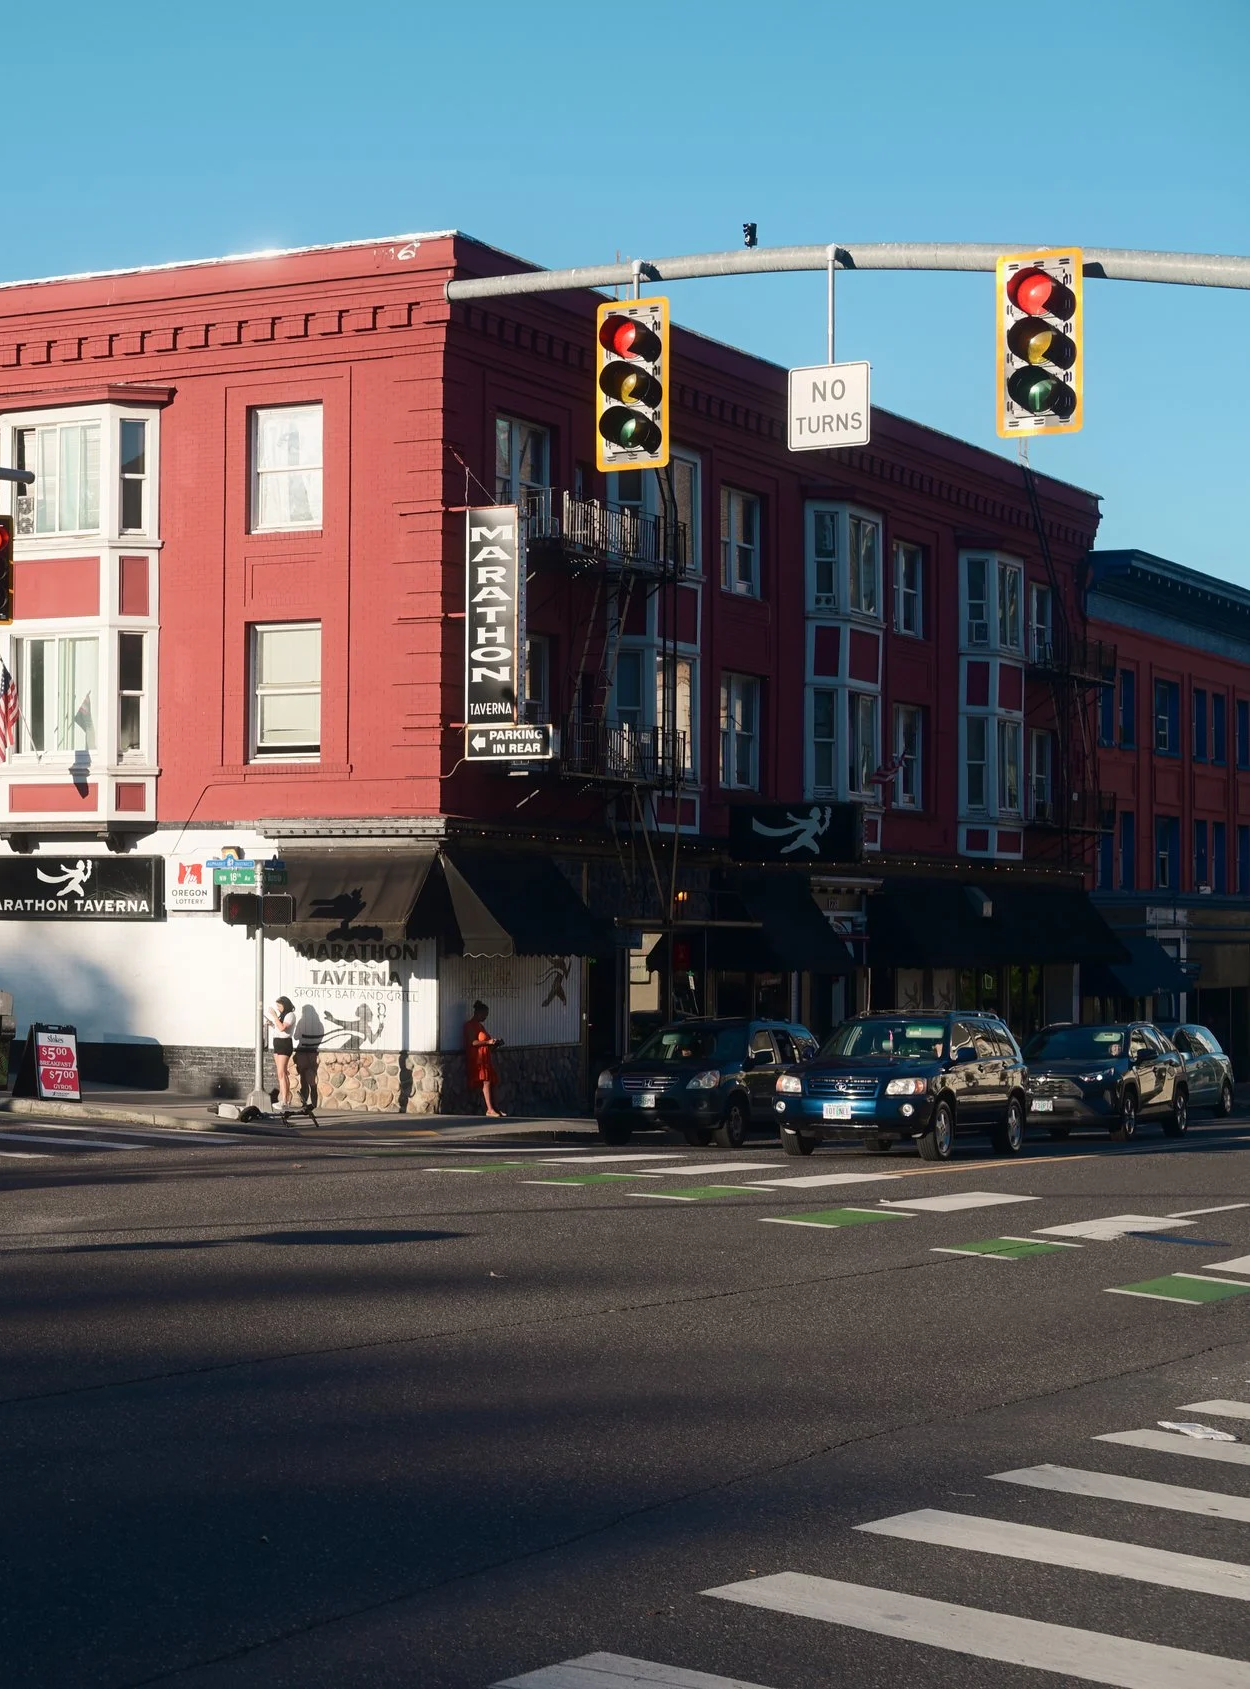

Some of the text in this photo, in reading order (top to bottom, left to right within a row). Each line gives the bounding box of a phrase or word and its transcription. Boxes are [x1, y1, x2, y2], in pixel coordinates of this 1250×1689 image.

[812, 379, 846, 403] NO
[795, 411, 863, 435] TURNS
[470, 524, 514, 683] MARATHON
[469, 702, 512, 716] TAVERNA
[489, 729, 543, 741] PARKING
[492, 743, 541, 754] IN REAR
[171, 889, 208, 897] OREGON
[74, 899, 150, 912] TAVERNA
[296, 943, 418, 961] MARATHON
[309, 969, 403, 987] TAVERNA
[293, 988, 419, 1002] SPORTS BAR AND GRILL
